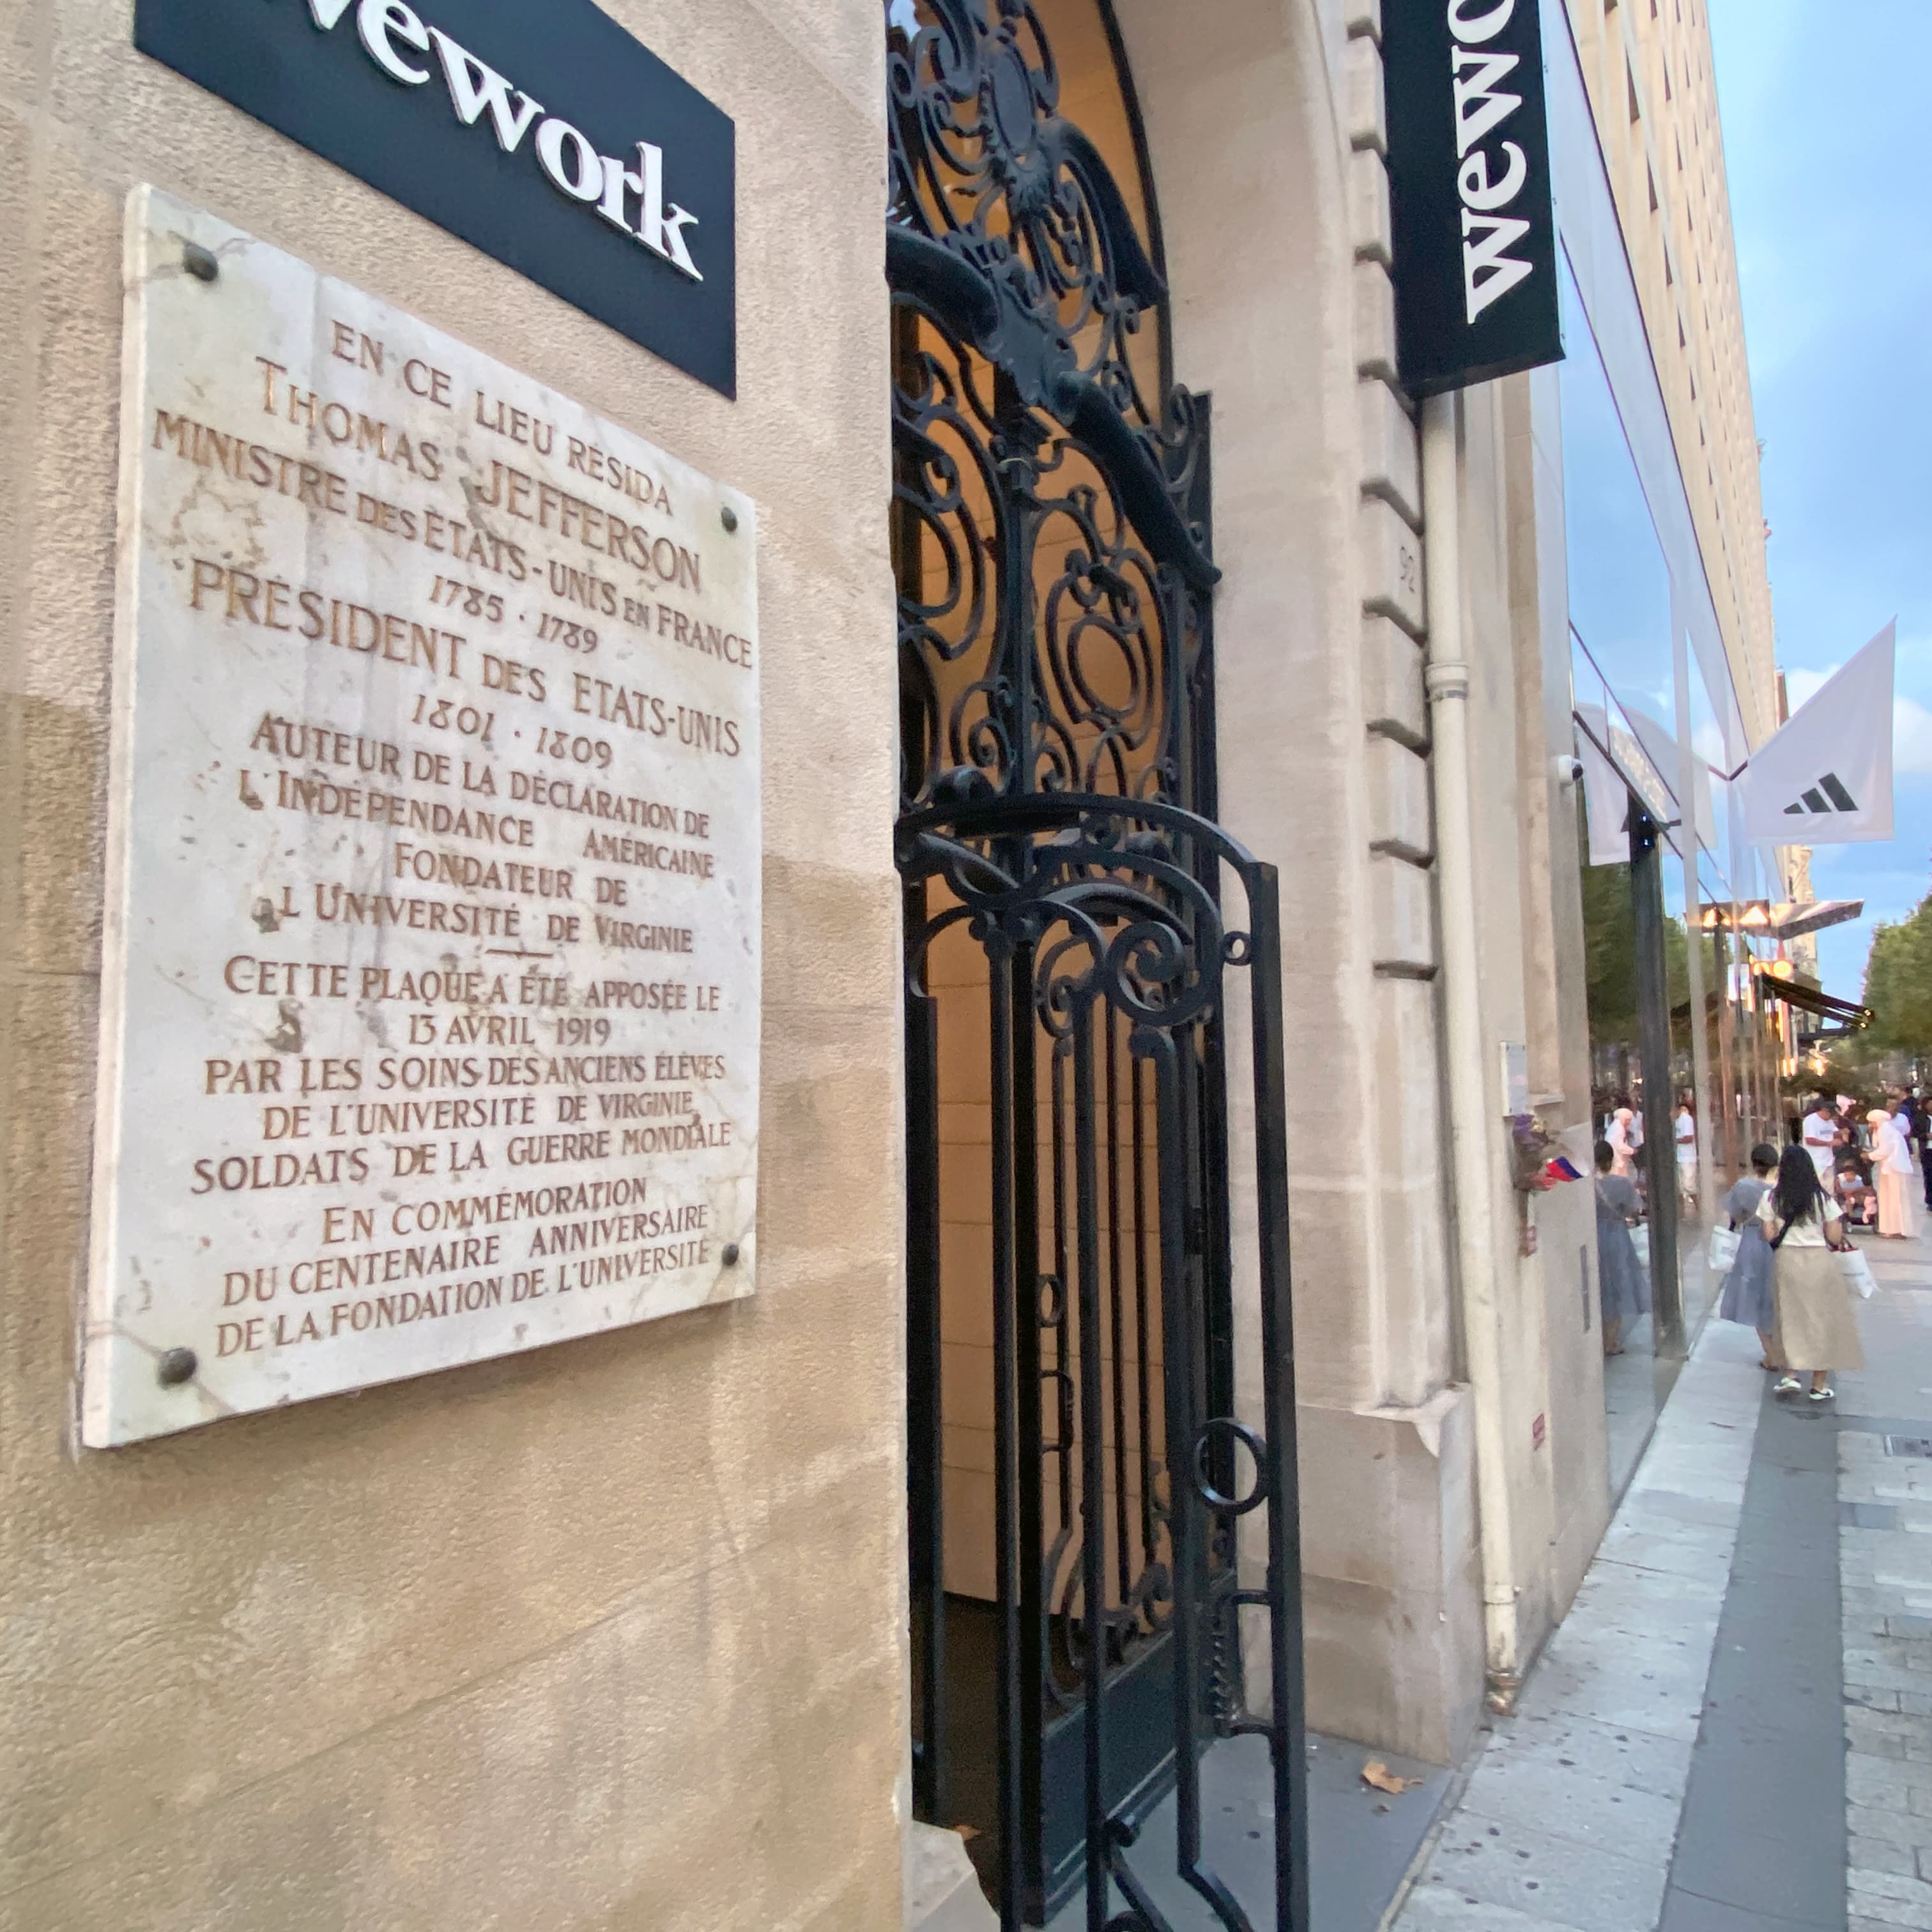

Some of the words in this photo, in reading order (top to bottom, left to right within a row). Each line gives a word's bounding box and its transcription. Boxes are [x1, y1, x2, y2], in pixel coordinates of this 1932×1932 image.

[332, 319, 383, 376] EN
[403, 359, 452, 408] CE
[475, 391, 554, 456] LIEU
[255, 355, 442, 482] THOMAS
[475, 459, 701, 595] JEFFERSON
[153, 408, 348, 514] MINISTRE
[355, 492, 417, 541] DES
[623, 597, 650, 631] EN
[656, 604, 753, 670] FRANCE
[429, 574, 505, 623] 1785
[537, 612, 599, 654] 1789
[411, 694, 494, 742] 1801
[535, 726, 613, 769] 1809
[482, 654, 547, 703] DES
[573, 671, 741, 758] ETATS-UNIS
[250, 712, 401, 778] AUTEUR
[413, 750, 450, 785] DE
[463, 761, 497, 797] LA
[684, 809, 710, 839] DE
[394, 841, 573, 900] FONDATEUR
[595, 876, 627, 907] DE
[547, 914, 581, 942] DE
[594, 914, 693, 953] VIRGINIE
[224, 954, 349, 998] CETTE
[360, 967, 482, 1008] PLAQUE
[488, 973, 509, 1004] A
[584, 979, 687, 1010] APPOSÉE
[696, 986, 720, 1011] LE
[445, 1015, 536, 1046] AVRIL
[556, 1017, 612, 1047] 1919
[204, 1058, 282, 1095] PAR
[300, 1057, 363, 1092] LES
[377, 1057, 480, 1091] SOINS
[488, 1057, 540, 1087] DES
[544, 1054, 647, 1086] ANCIENS
[263, 1105, 311, 1140] DE
[557, 1095, 587, 1123] DE
[190, 1147, 370, 1195] SOLDATS
[393, 1143, 437, 1177] DE
[449, 1139, 489, 1172] LA
[507, 1129, 611, 1167] GUERRE
[622, 1121, 732, 1156] MONDIALE
[222, 1266, 279, 1308] DU
[290, 1234, 500, 1296] CENTENAIRE
[528, 1204, 709, 1258] ANNIVERSAIRE
[322, 1206, 376, 1245] EN
[215, 1317, 264, 1359] DE
[275, 1310, 322, 1347] LA
[329, 1275, 503, 1337] FONDATION
[511, 1268, 545, 1303] DE
